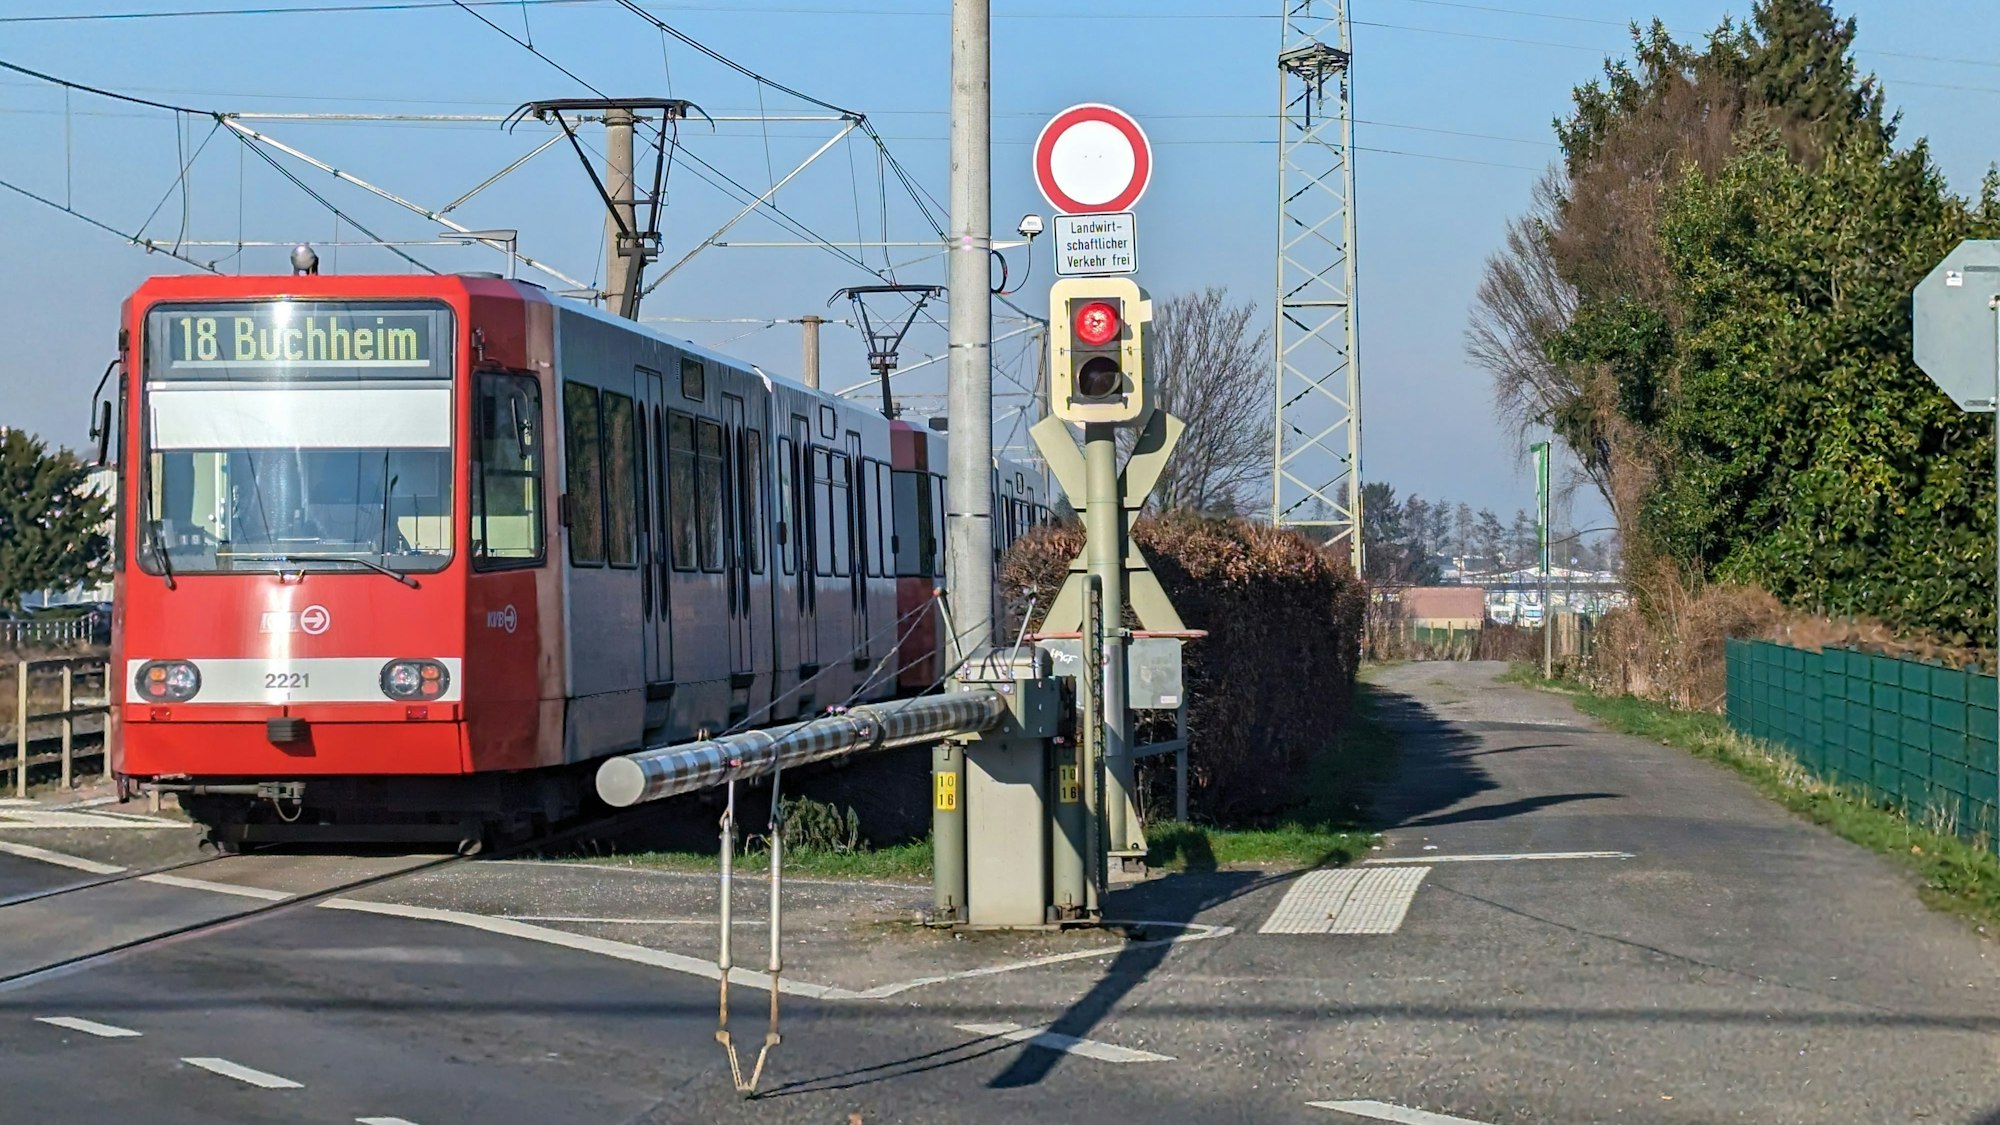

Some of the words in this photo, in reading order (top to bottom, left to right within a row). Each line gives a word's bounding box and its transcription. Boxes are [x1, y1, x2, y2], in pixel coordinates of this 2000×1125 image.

[1071, 221, 1122, 234] Landwirt-
[1067, 237, 1127, 251] schaftlicher
[1067, 254, 1106, 268] Verkehr
[1112, 252, 1130, 266] frei
[180, 317, 217, 361] 18
[234, 316, 417, 361] Buchheim
[487, 611, 504, 628] KVB
[265, 673, 309, 688] 2221
[939, 775, 954, 787] 10
